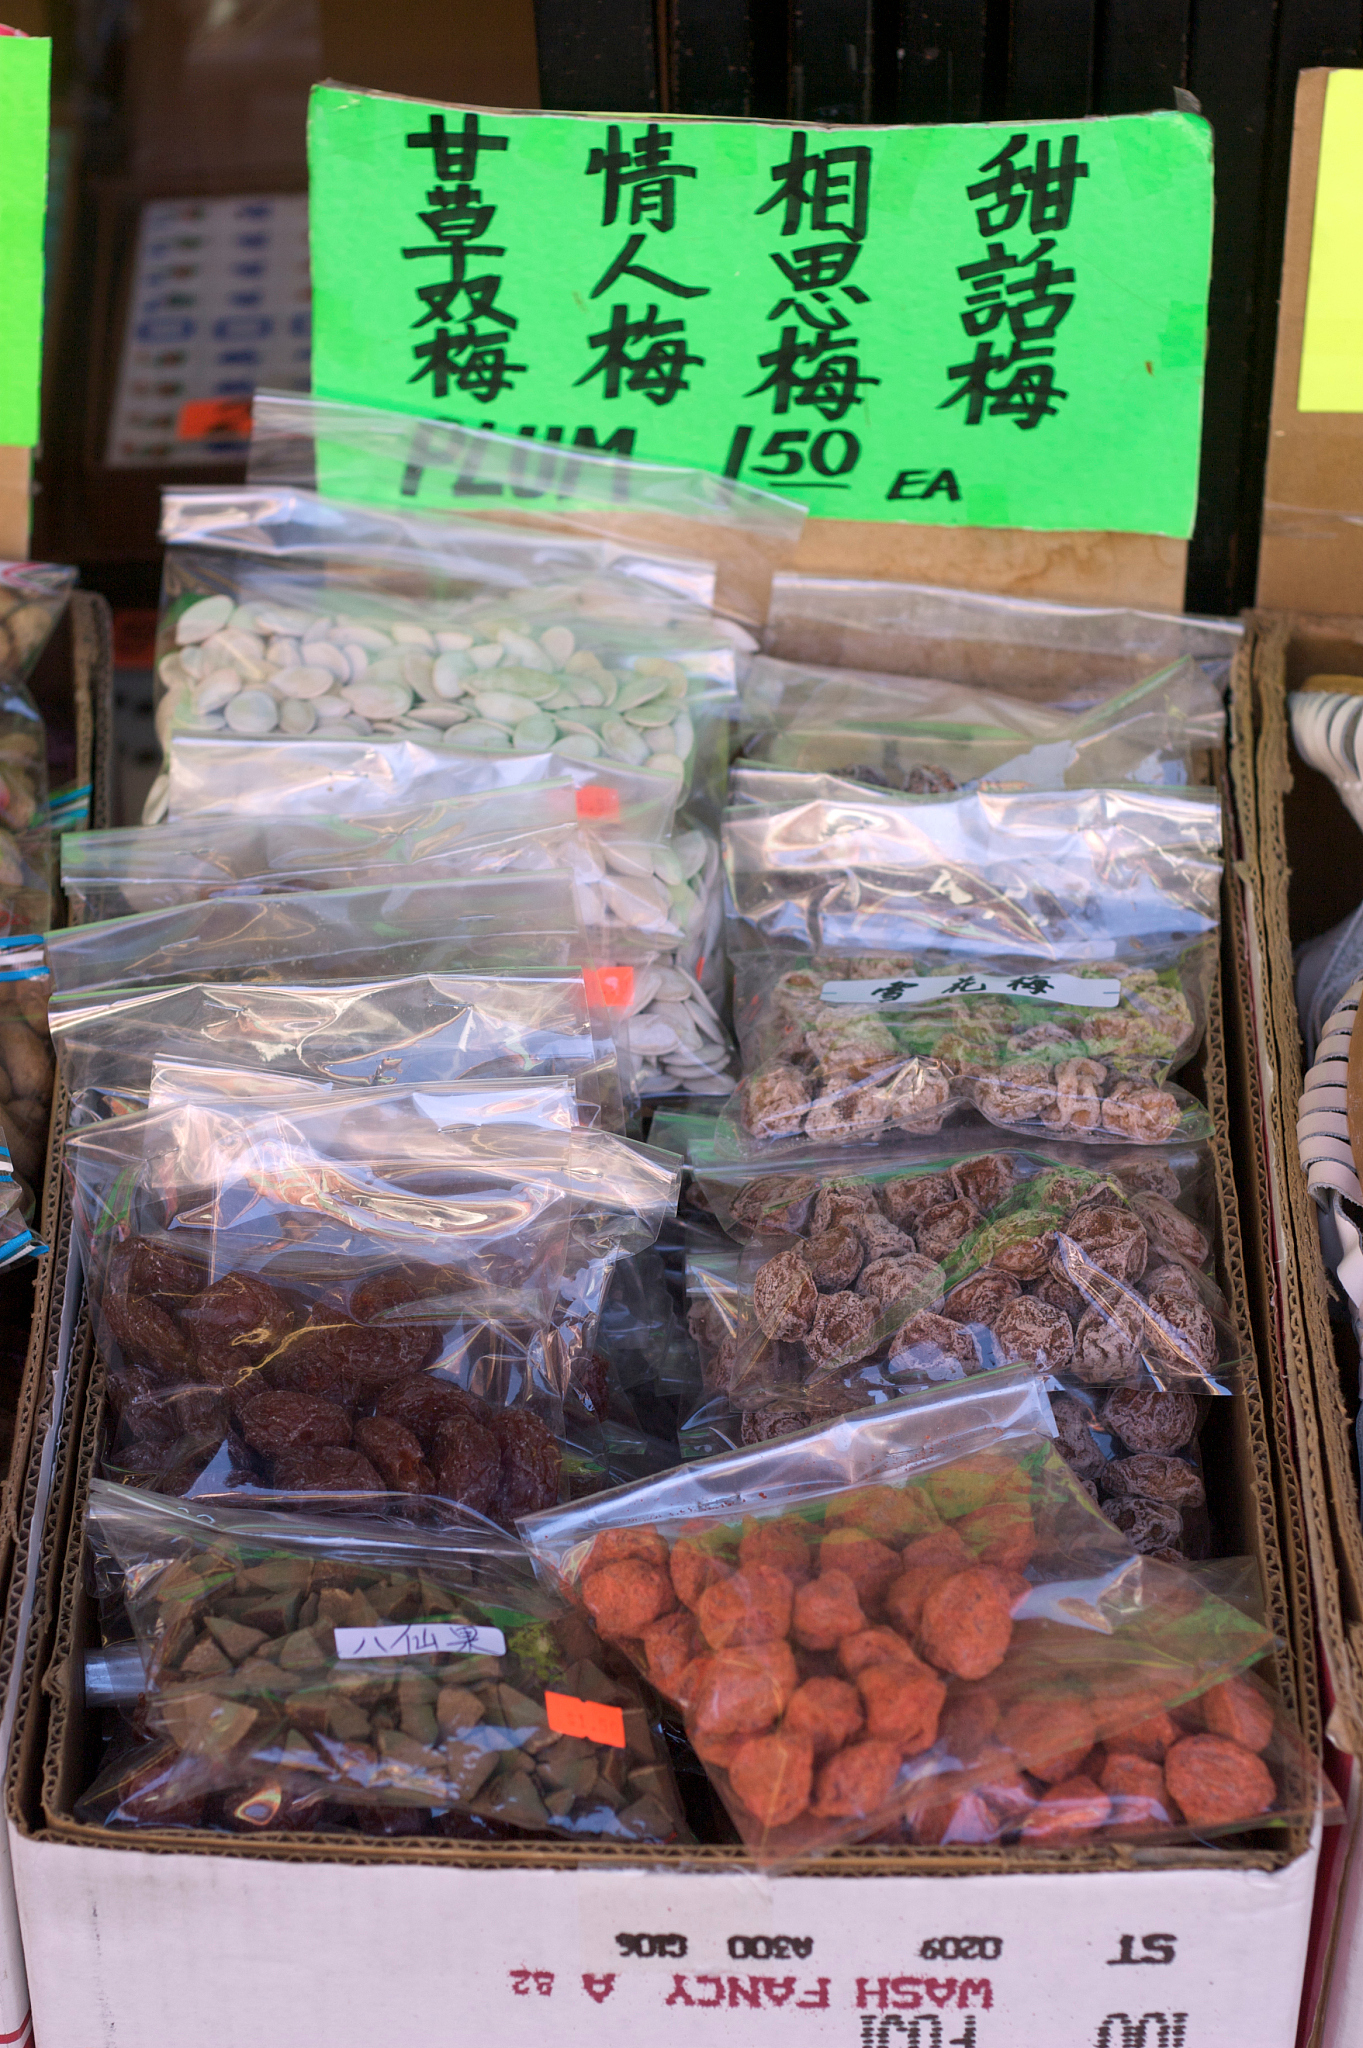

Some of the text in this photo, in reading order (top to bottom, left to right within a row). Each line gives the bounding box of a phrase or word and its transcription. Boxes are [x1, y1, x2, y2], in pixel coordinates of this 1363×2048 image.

[402, 113, 528, 404] 甘草双梅
[573, 124, 711, 406] 情人梅
[745, 132, 881, 422] 相思梅
[938, 134, 1089, 430] 甜話梅
[886, 469, 962, 502] EA
[353, 1624, 501, 1655] 八仙果
[1106, 1933, 1177, 1966] ST
[581, 1972, 617, 2004] A
[664, 1974, 831, 2009] FANCY
[855, 1976, 994, 2011] WASH
